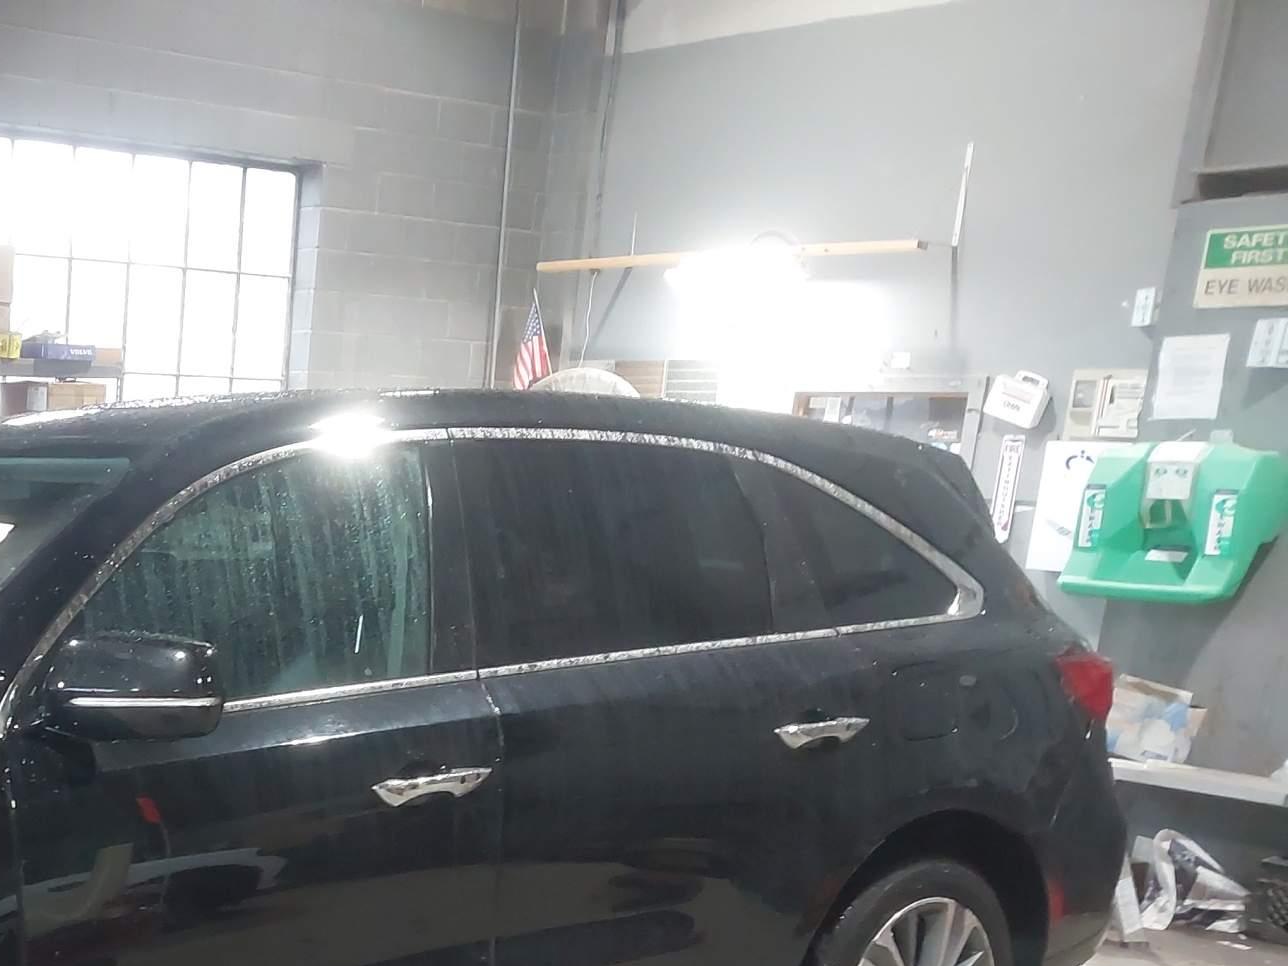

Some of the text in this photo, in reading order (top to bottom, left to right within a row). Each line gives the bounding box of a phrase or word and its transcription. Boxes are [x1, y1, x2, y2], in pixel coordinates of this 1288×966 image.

[1230, 248, 1285, 264] FIRST
[1204, 276, 1288, 295] EYE WAS
